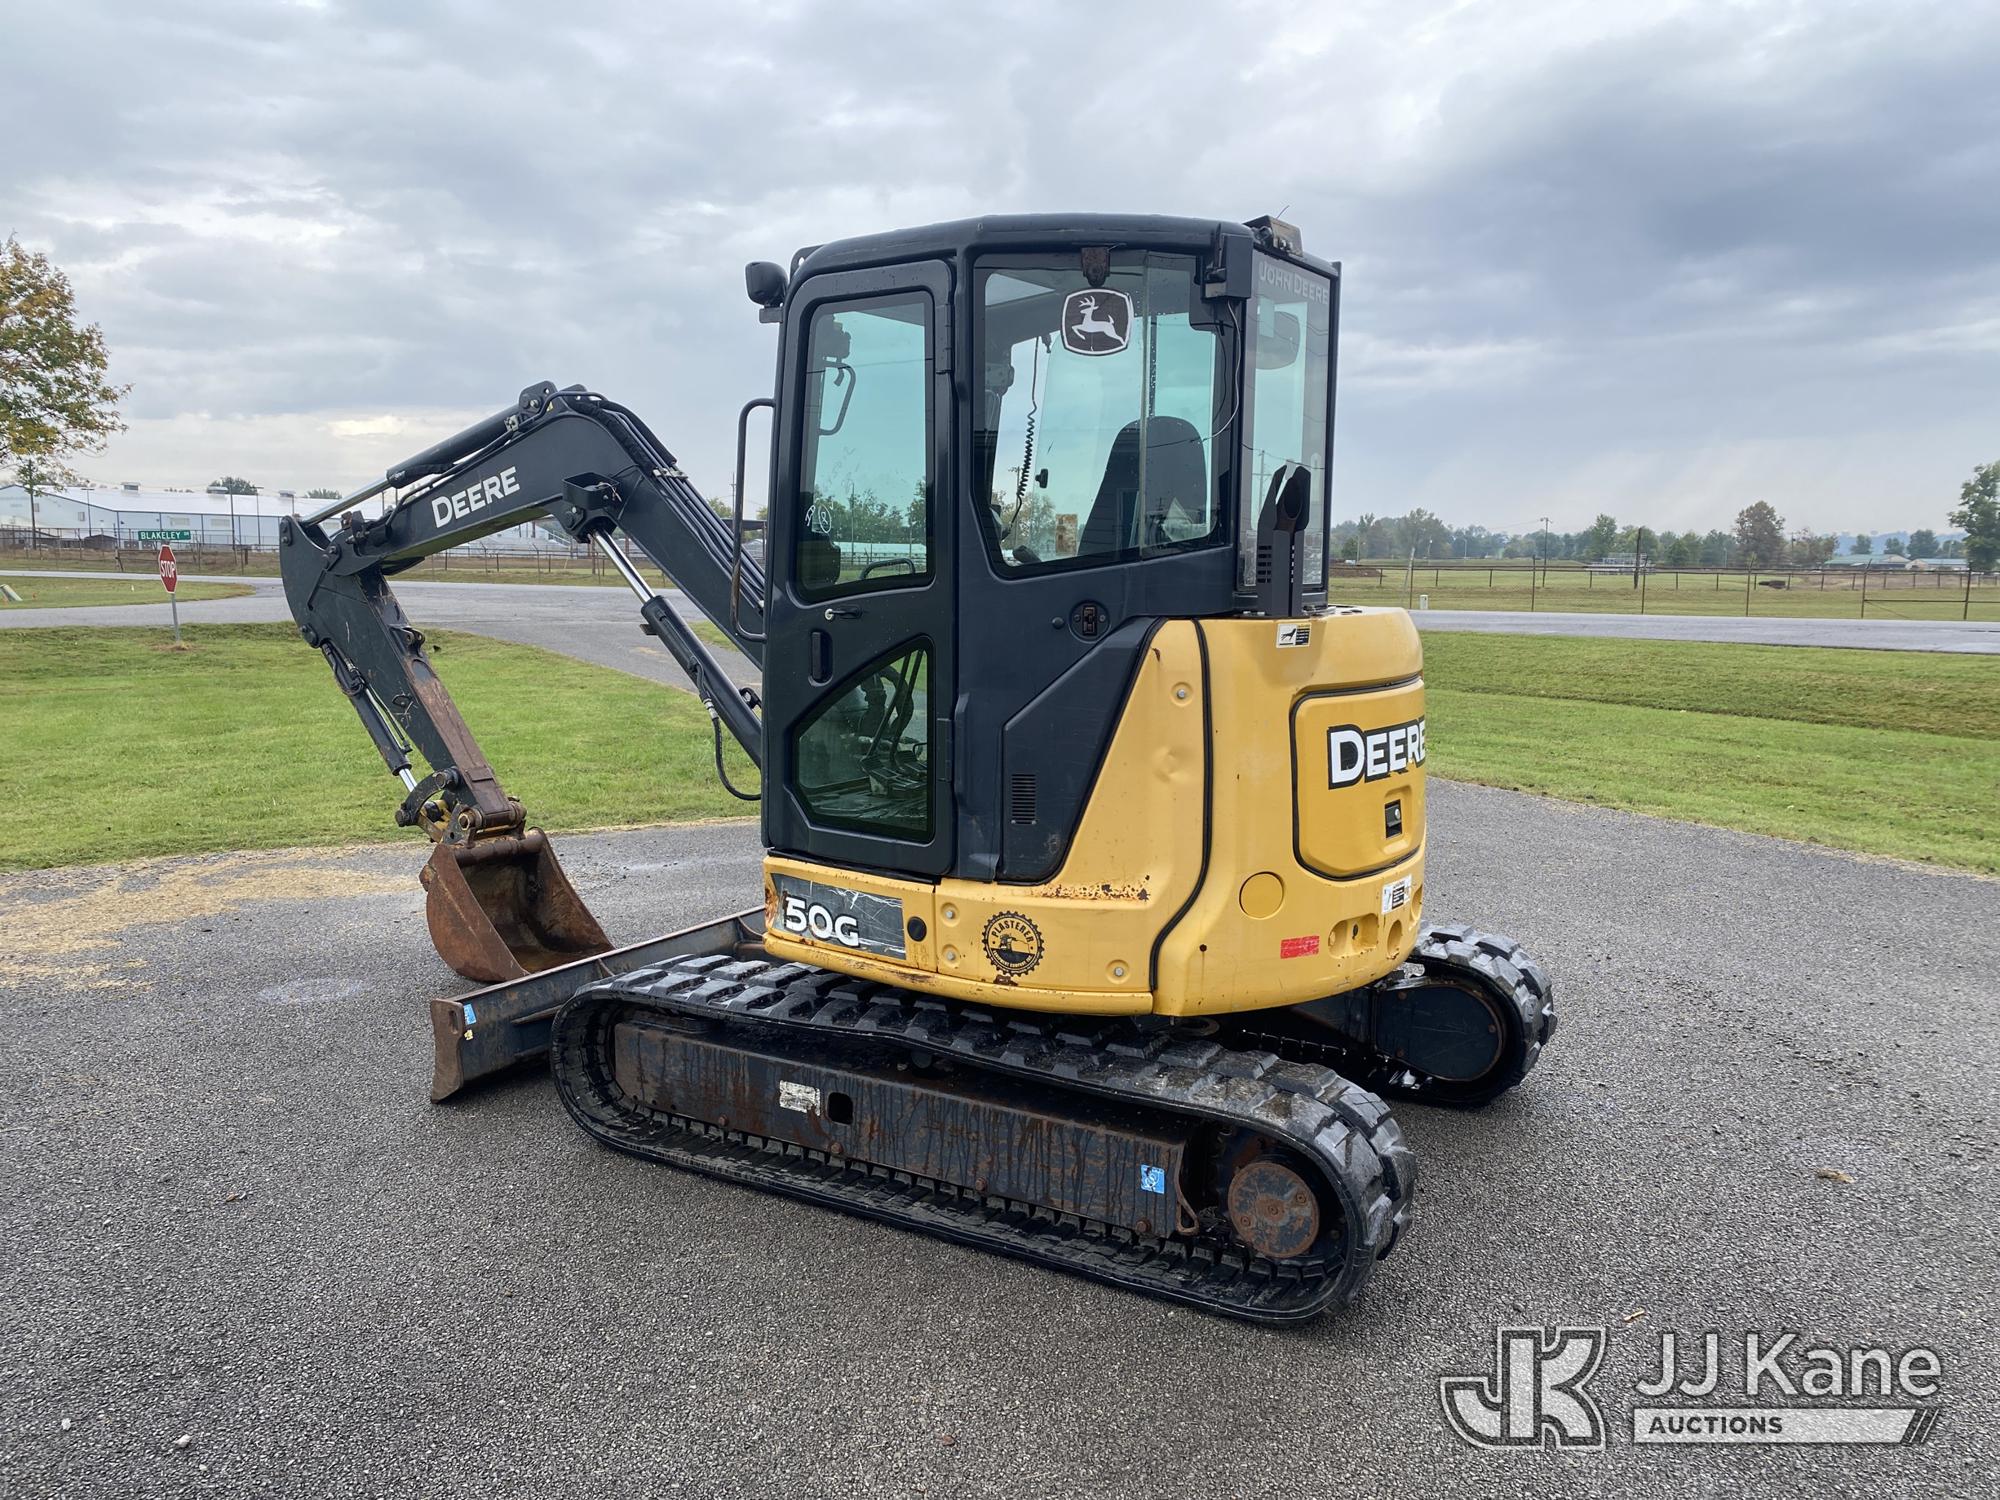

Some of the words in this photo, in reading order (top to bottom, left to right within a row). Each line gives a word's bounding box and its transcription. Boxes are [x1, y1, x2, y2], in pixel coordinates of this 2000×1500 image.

[1259, 261, 1291, 291] JOHN
[1294, 272, 1329, 304] DEERE
[431, 466, 520, 528] DEERE
[140, 531, 181, 540] BLAKELEY
[160, 560, 176, 578] STOP
[1329, 718, 1426, 786] DEERE
[785, 896, 860, 947] 50G
[991, 920, 1035, 943] PLASTERER
